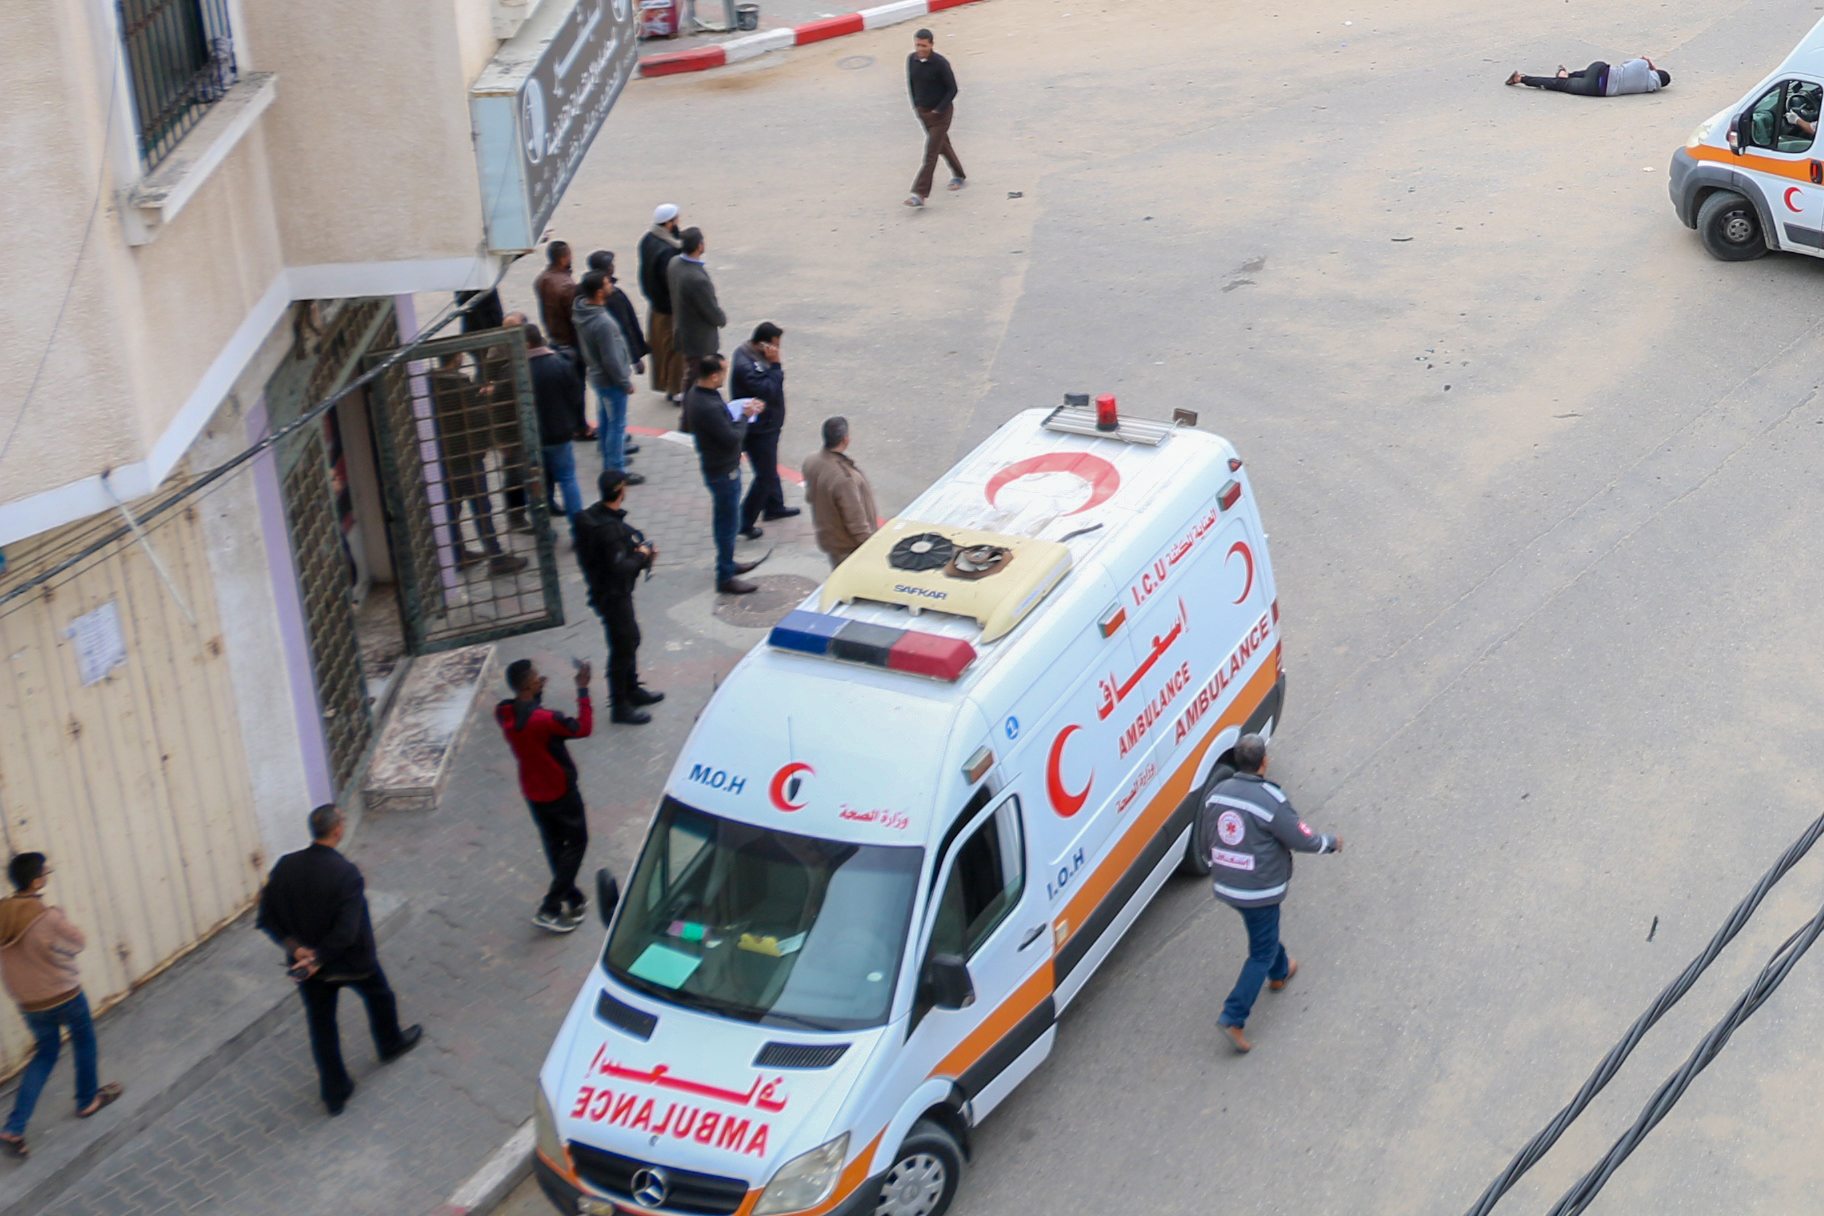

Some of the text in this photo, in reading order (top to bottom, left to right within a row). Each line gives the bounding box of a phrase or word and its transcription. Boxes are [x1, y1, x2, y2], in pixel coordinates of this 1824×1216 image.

[893, 584, 948, 600] SAFKAR
[1131, 557, 1167, 607] I.C.U
[1095, 595, 1190, 721] إسعاف
[1175, 615, 1270, 746] AMBULANCE
[1118, 661, 1192, 760] AMBULANCE
[688, 763, 748, 796] M.O.H
[838, 803, 910, 830] وزارة الصحة
